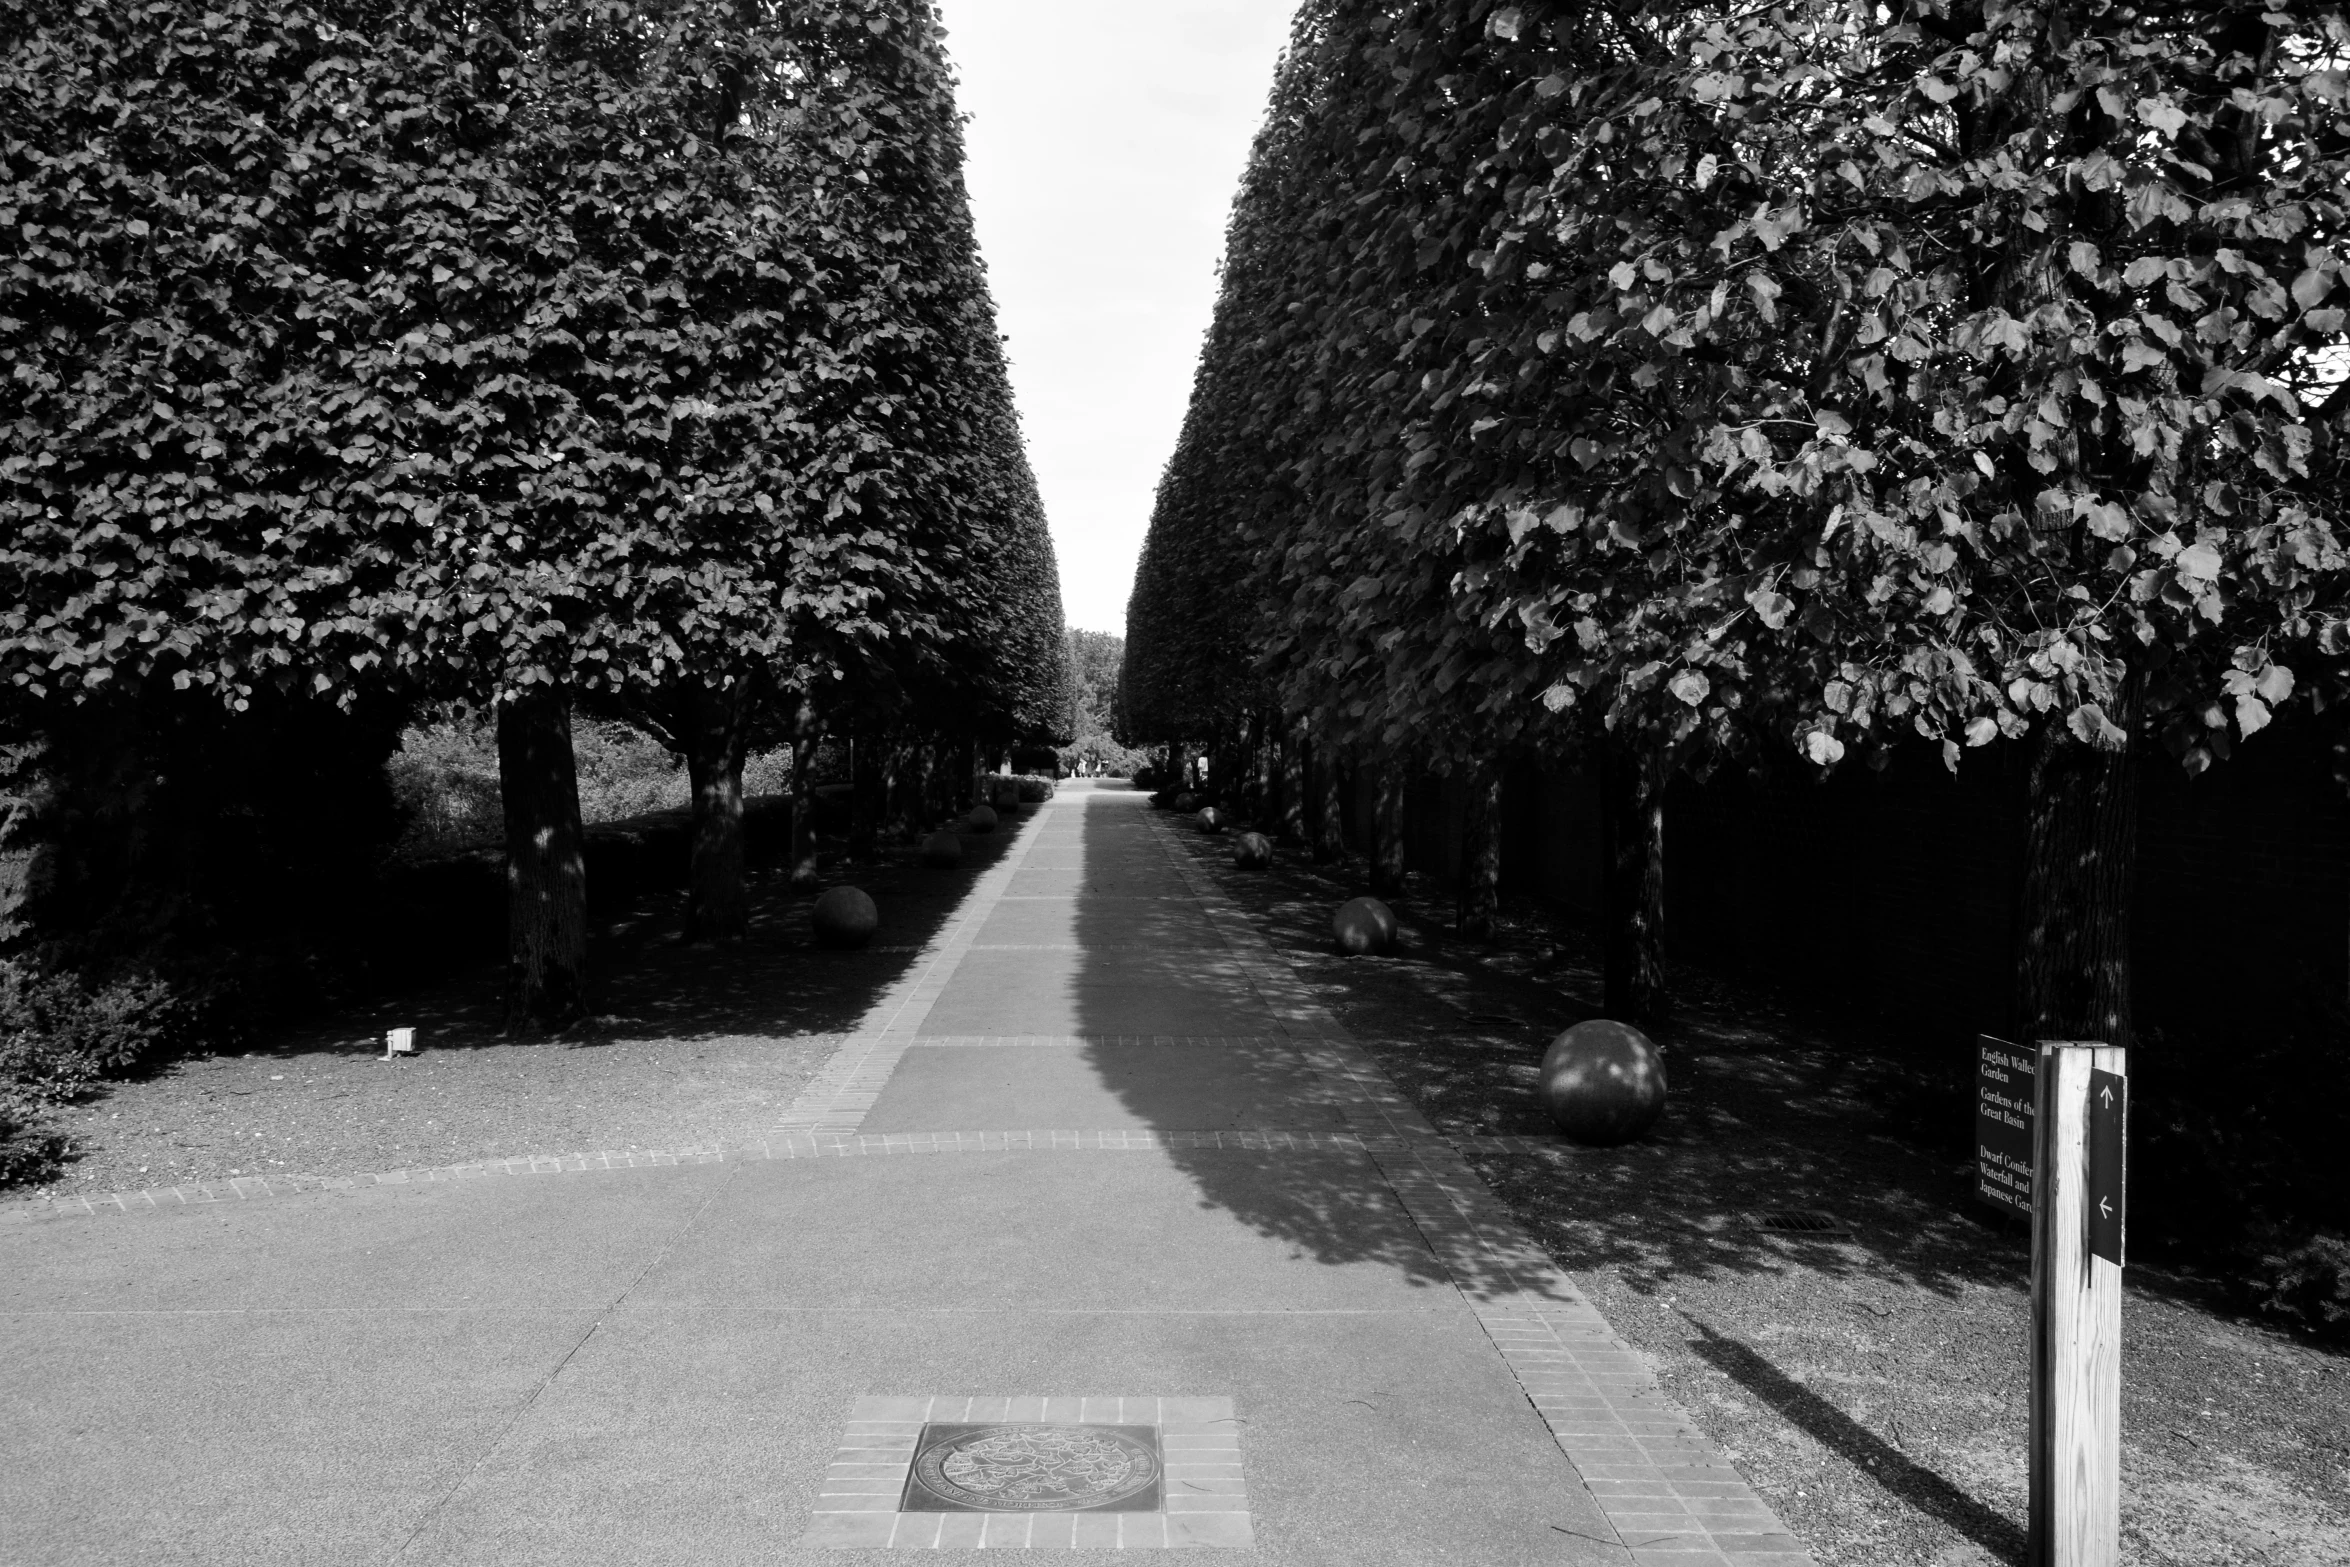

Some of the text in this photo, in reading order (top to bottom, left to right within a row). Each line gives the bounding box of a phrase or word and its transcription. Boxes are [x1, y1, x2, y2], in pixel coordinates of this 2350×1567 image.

[1981, 1047, 2009, 1067] English
[1981, 1064, 2009, 1083] Garden
[1980, 1086, 2035, 1116] Gardens of the
[1980, 1102, 2025, 1130] Great Basin
[1980, 1144, 2034, 1178] Dwarf Conifer
[1979, 1161, 2030, 1194] Waterfall and
[1979, 1178, 2013, 1204] Japanese
